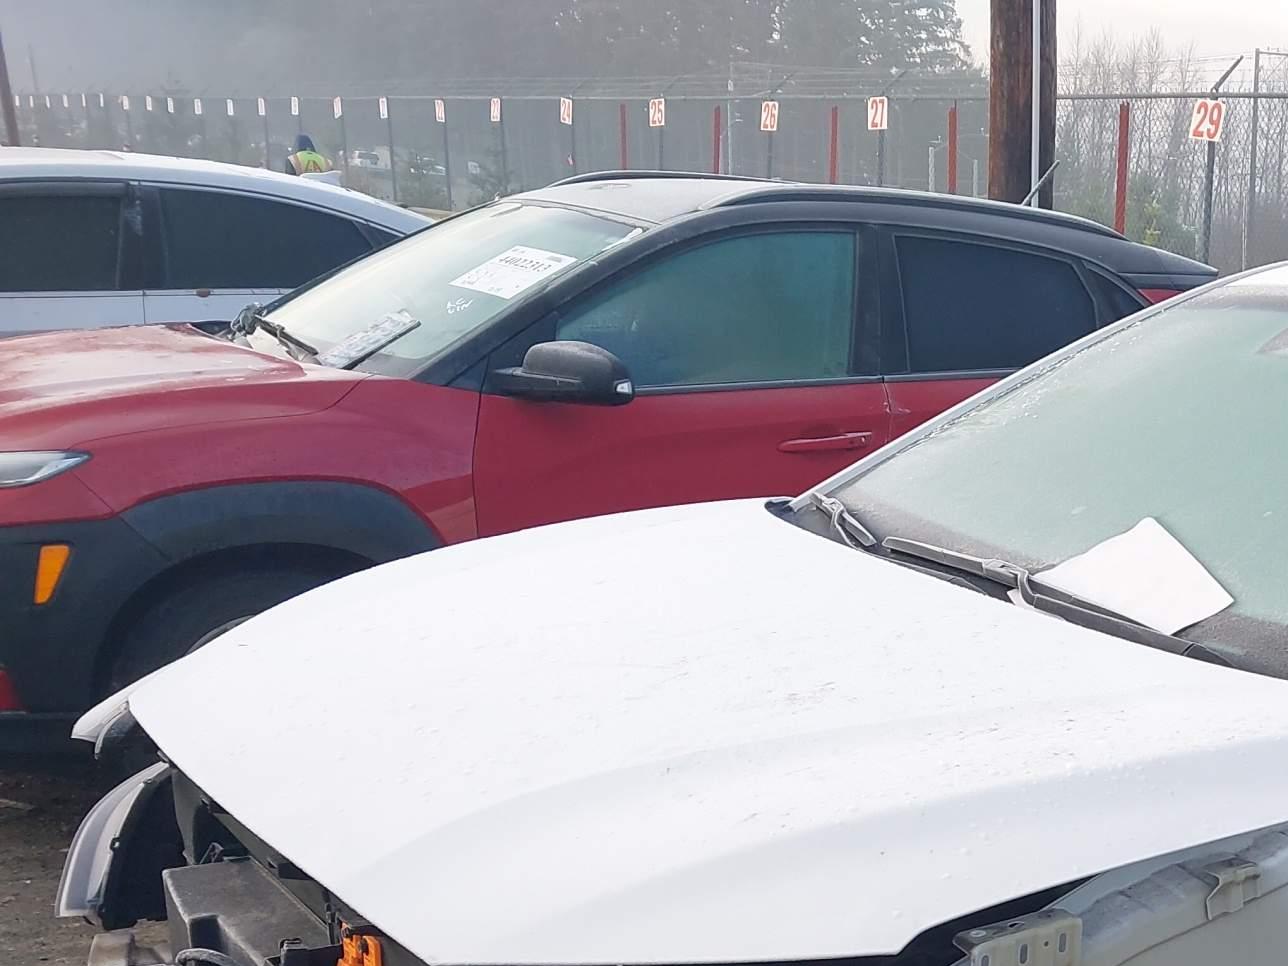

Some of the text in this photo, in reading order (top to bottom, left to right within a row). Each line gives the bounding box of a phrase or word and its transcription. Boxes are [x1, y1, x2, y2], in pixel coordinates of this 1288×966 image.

[561, 99, 571, 122] 24
[649, 100, 664, 125] 25
[762, 102, 777, 130] 26
[869, 98, 887, 129] 27
[1191, 101, 1222, 140] 29
